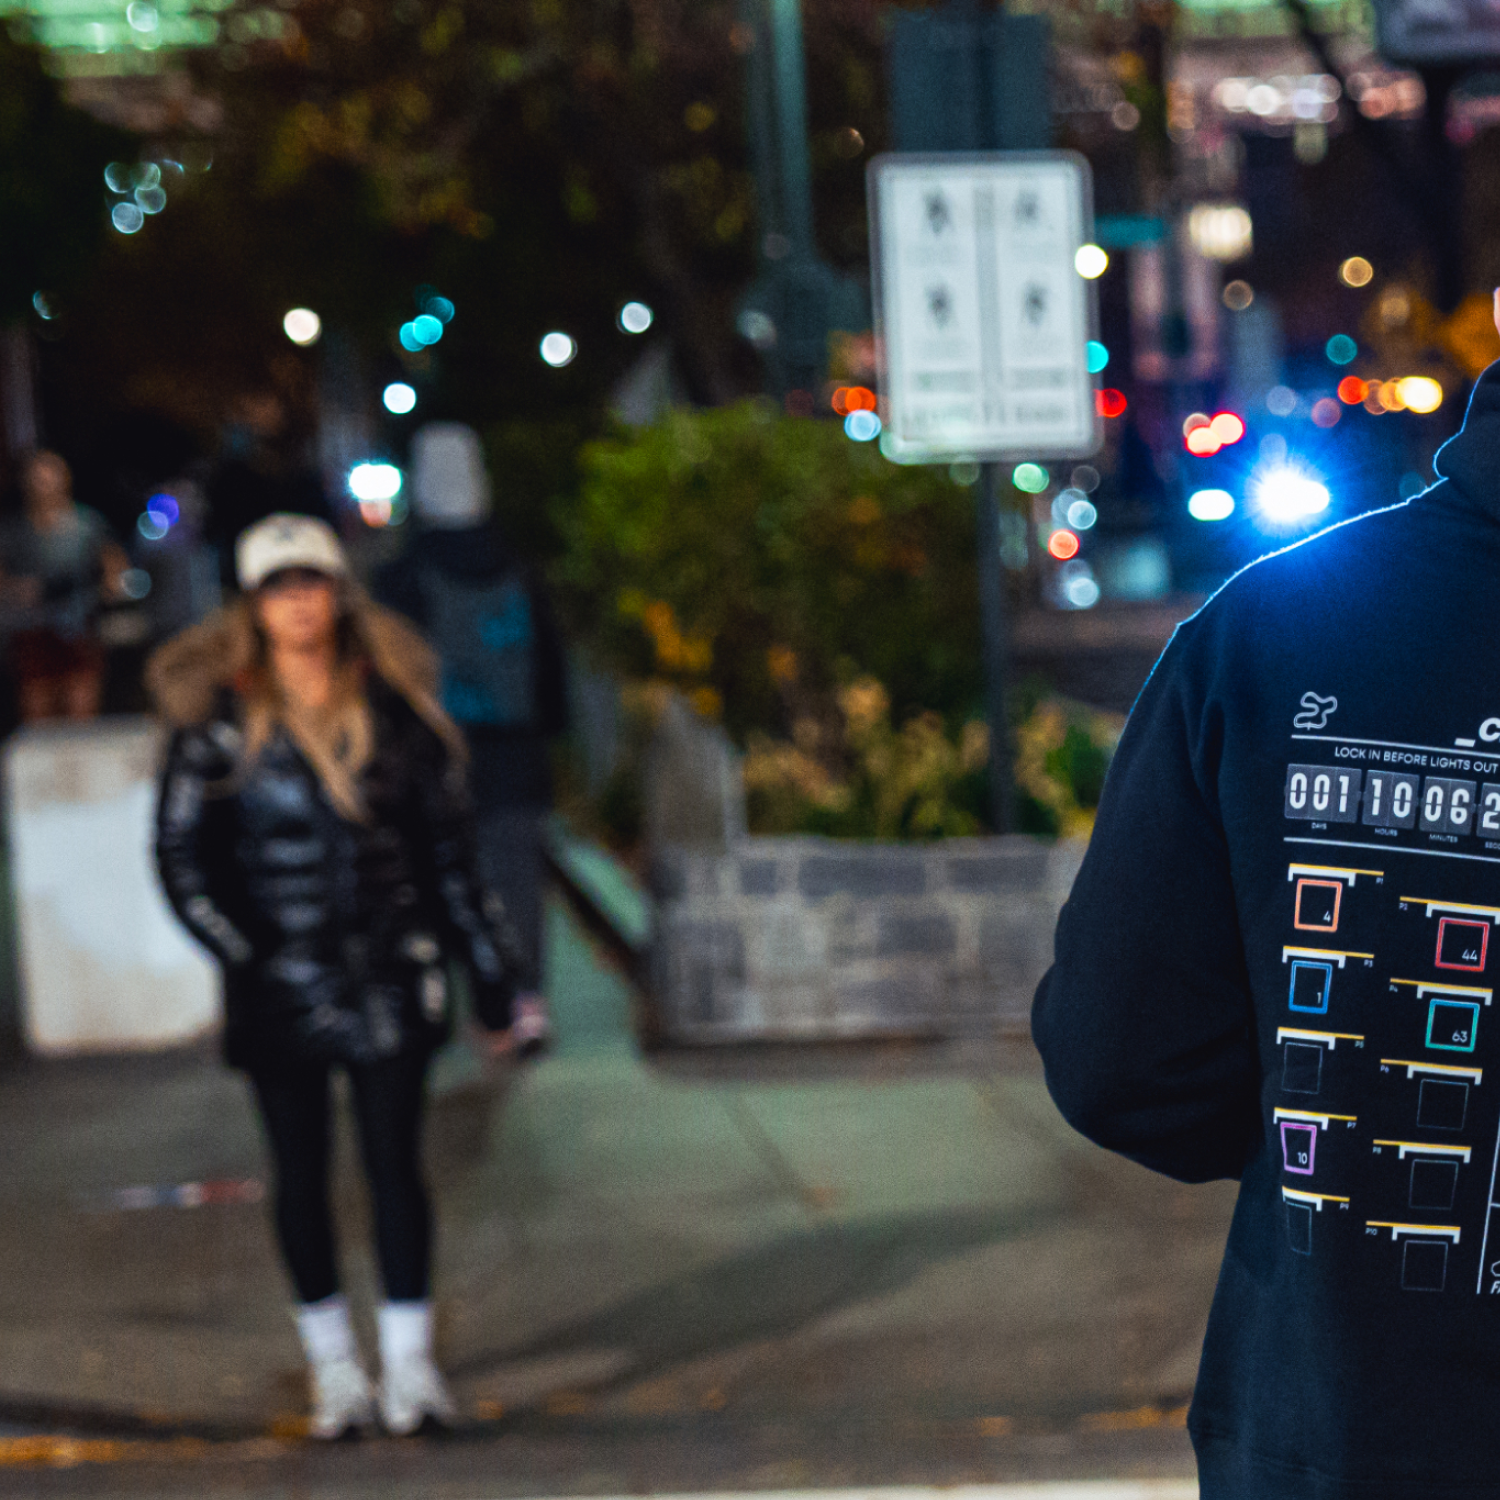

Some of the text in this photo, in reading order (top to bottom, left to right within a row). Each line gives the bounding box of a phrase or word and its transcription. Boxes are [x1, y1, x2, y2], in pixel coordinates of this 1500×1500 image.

[1334, 746, 1499, 774] LOCK IN BEFORE LIGHTS OUT
[1288, 772, 1350, 813] 001
[1370, 778, 1413, 818] 10
[1423, 785, 1470, 825] 06
[1323, 910, 1331, 922] 4
[1461, 949, 1478, 962] 44
[1452, 1030, 1468, 1043] 63
[1297, 1151, 1308, 1165] 10
